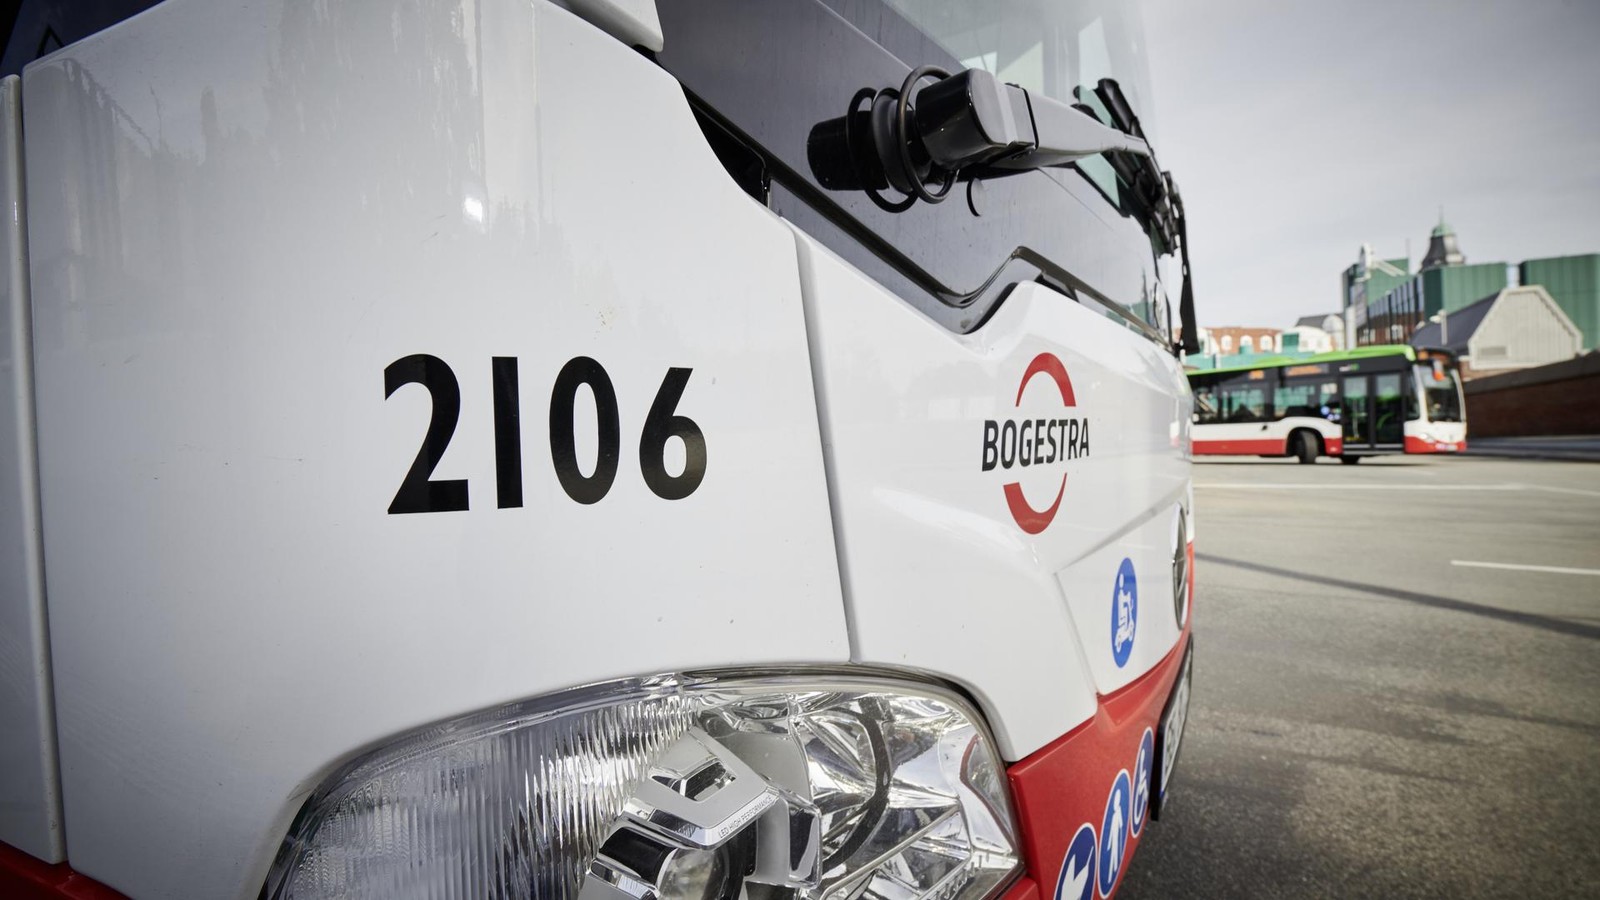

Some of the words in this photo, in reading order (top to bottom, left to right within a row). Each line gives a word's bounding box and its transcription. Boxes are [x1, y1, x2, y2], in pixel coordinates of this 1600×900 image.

[384, 354, 707, 514] 2106
[982, 418, 1090, 472] BOGESTRA
[718, 826, 729, 838] LED
[729, 817, 742, 831] HIGH
[741, 795, 773, 821] PERFORMANCE
